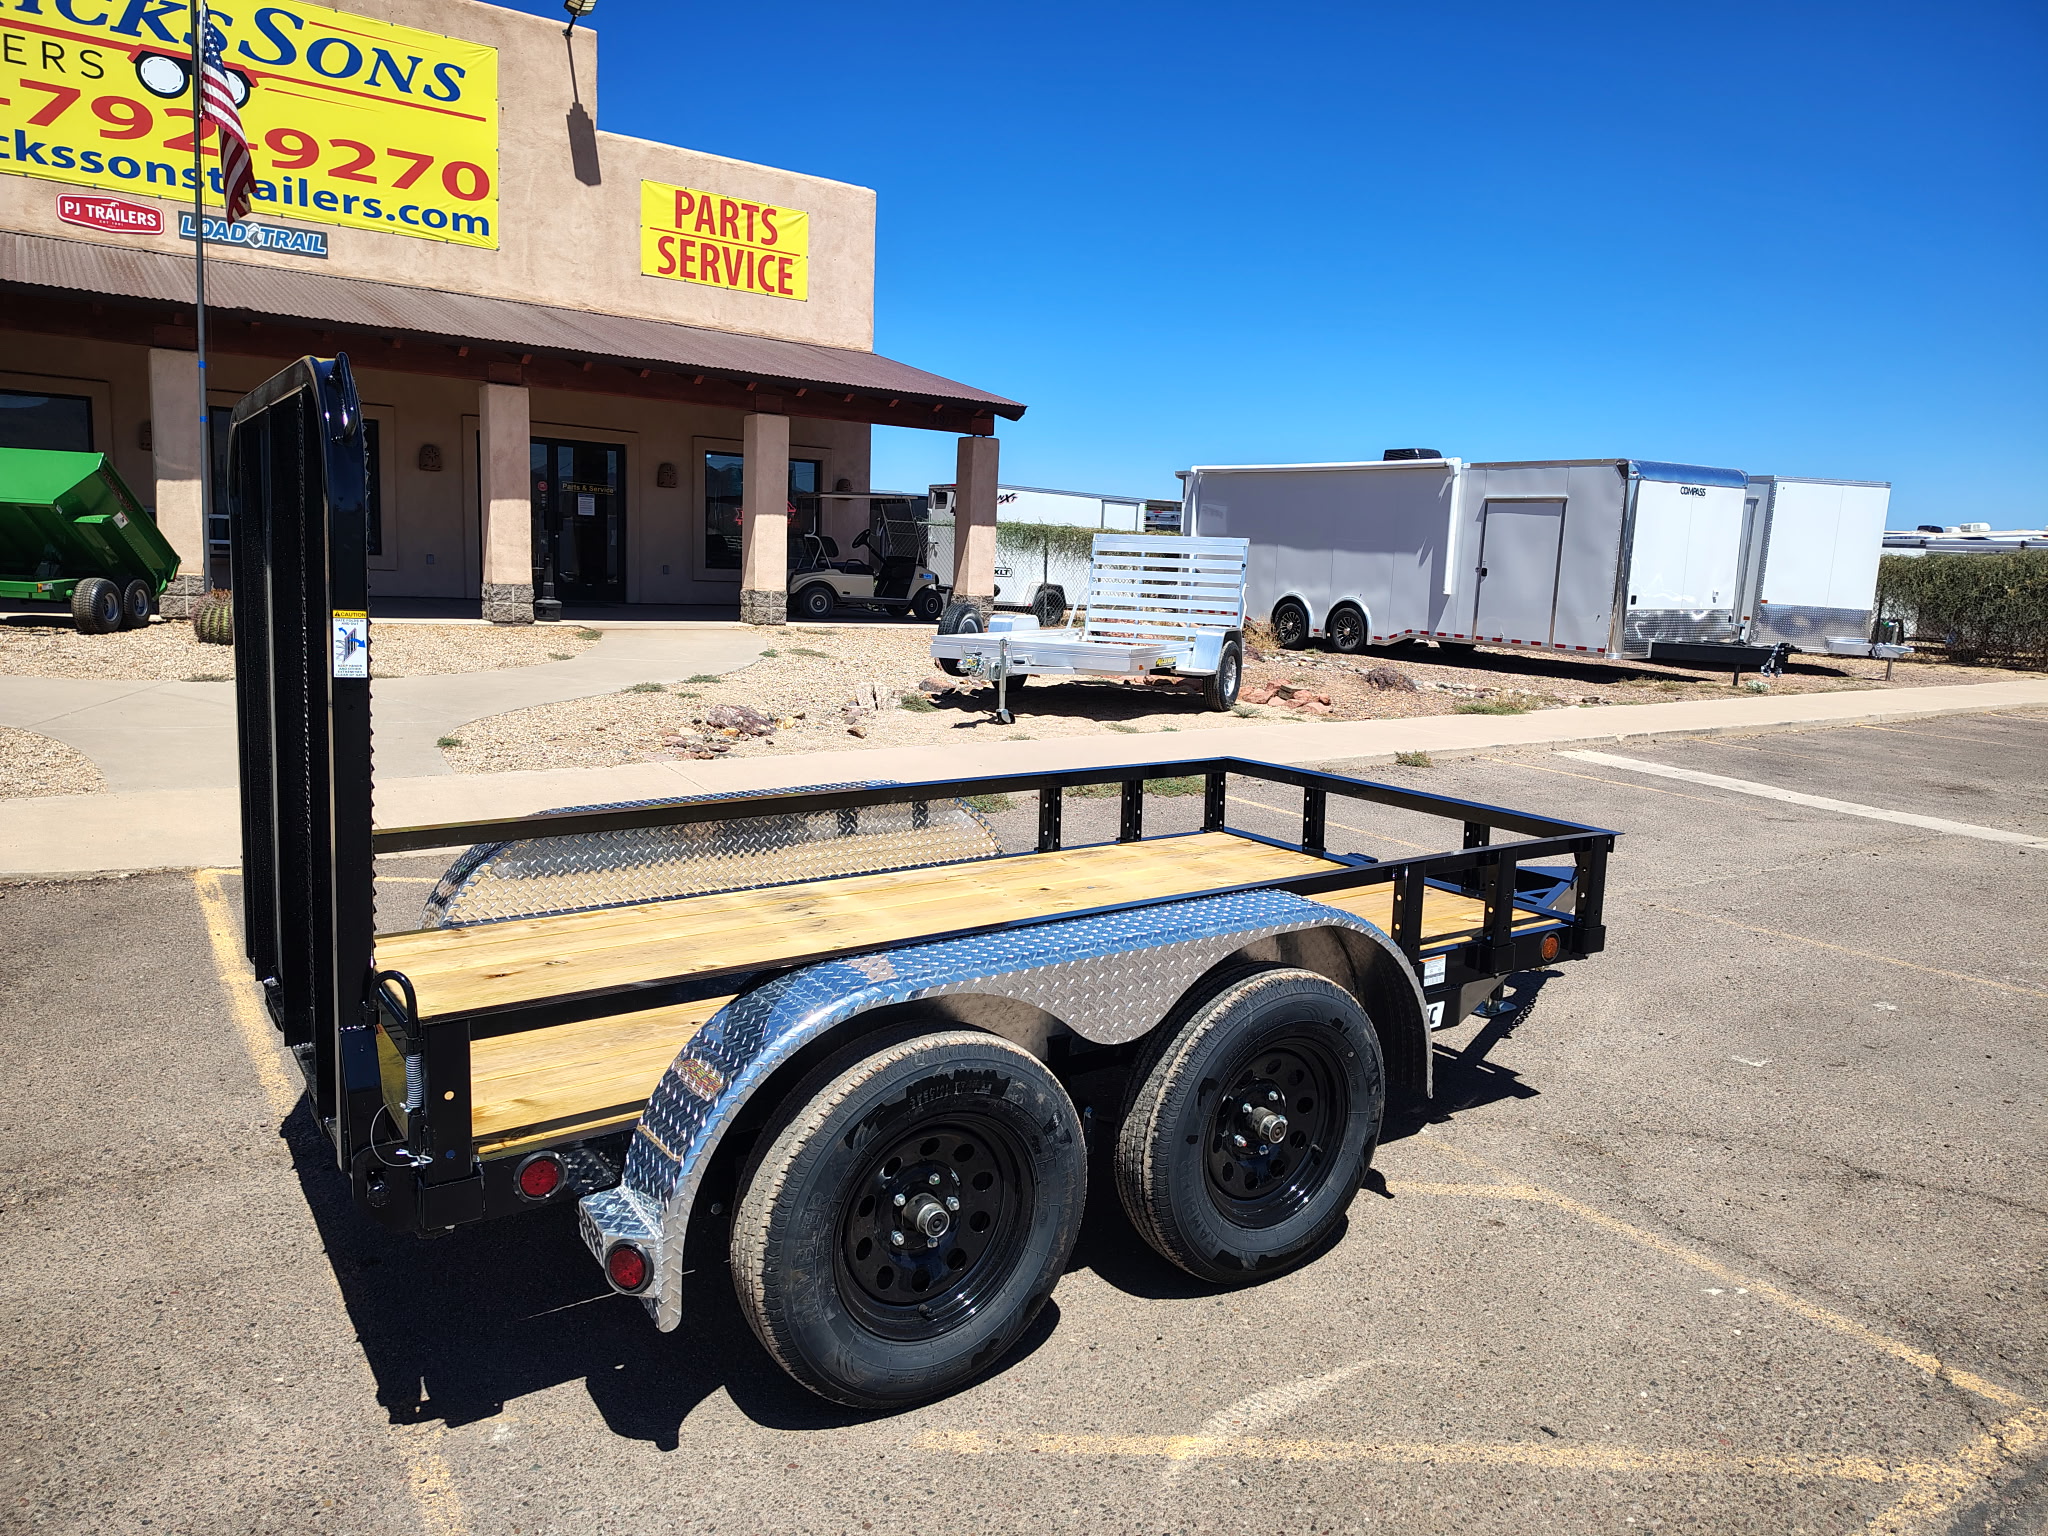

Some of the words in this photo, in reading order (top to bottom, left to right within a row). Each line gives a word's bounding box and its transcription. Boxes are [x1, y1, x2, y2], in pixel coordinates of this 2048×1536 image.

[0, 78, 490, 201] 7929270
[0, 129, 489, 236] kssonstailers.com
[64, 201, 80, 215] PJ
[85, 204, 157, 226] TRAILERS
[181, 216, 248, 243] LOAD
[259, 227, 327, 254] TRAIL
[675, 190, 778, 245] PARTS
[657, 235, 793, 295] SERVICE
[562, 483, 580, 491] Parts
[1680, 486, 1706, 496] COMPASS
[790, 1190, 827, 1326] RAMBLER
